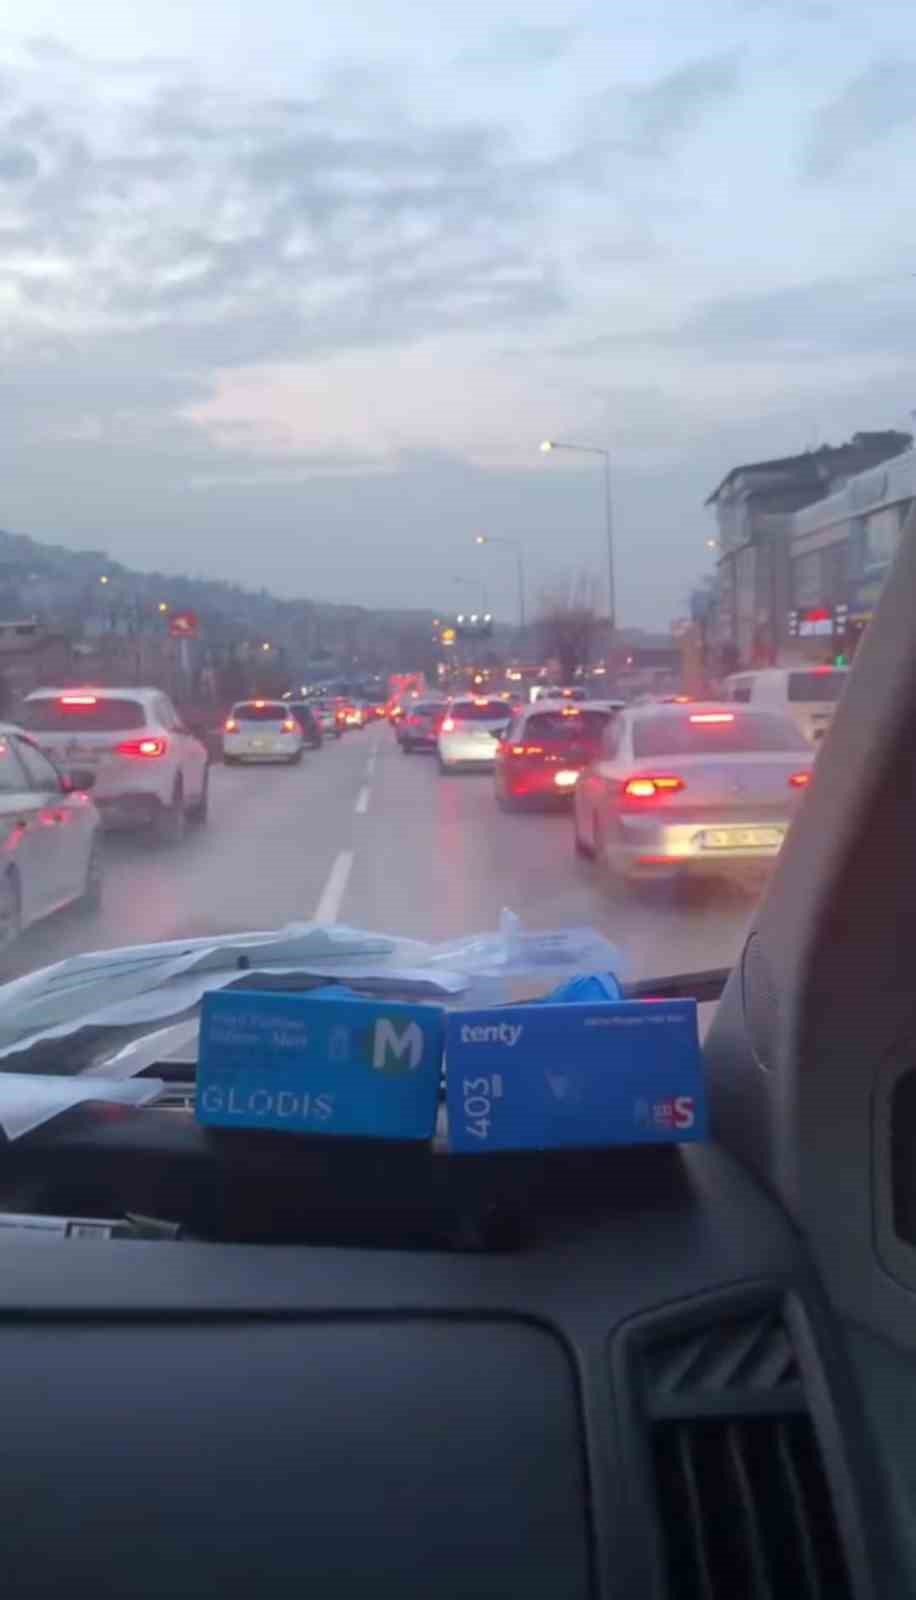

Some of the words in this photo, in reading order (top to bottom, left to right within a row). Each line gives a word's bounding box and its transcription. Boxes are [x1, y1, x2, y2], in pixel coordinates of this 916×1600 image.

[373, 1018, 424, 1069] M
[461, 1022, 522, 1046] tenty
[202, 1084, 333, 1120] GLODIS
[464, 1077, 491, 1138] 403
[674, 1097, 695, 1128] S
